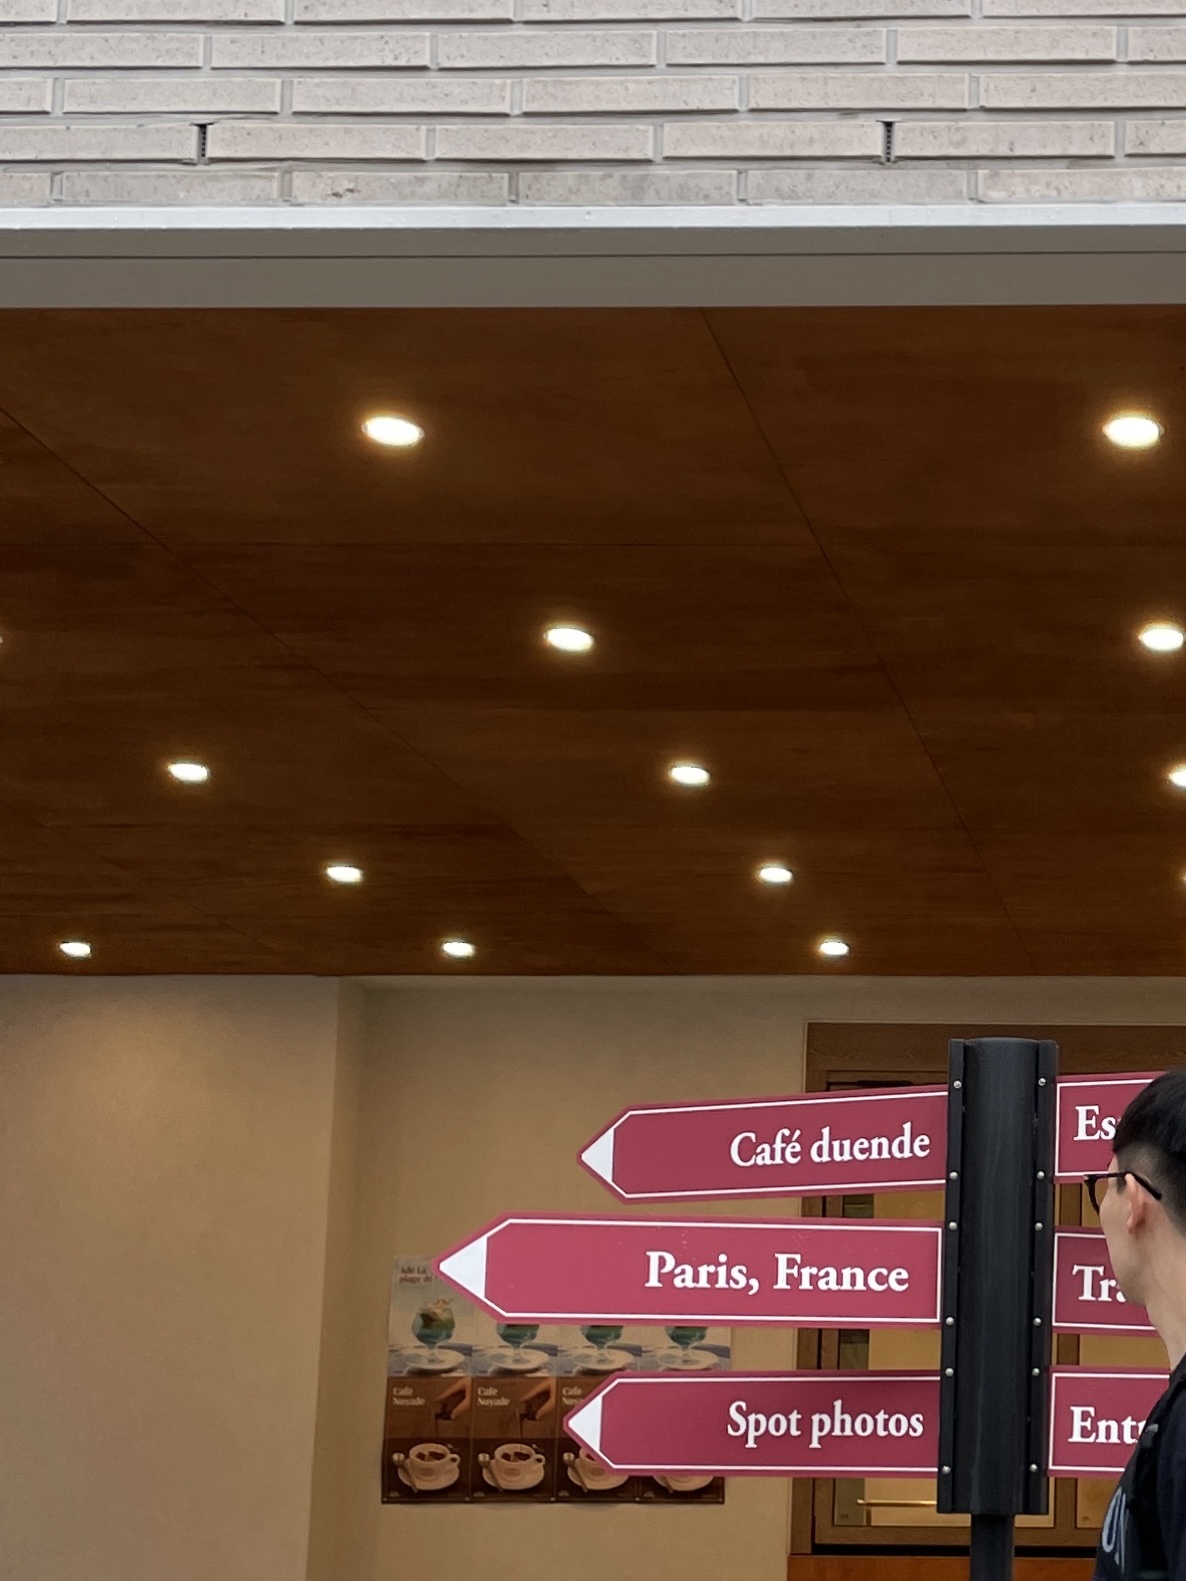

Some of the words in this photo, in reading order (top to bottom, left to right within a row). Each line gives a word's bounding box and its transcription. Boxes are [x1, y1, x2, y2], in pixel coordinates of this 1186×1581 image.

[729, 1127, 802, 1167] Café
[810, 1121, 931, 1163] duende
[644, 1250, 760, 1296] Paris,
[772, 1252, 910, 1292] France
[727, 1400, 802, 1448] Spot
[809, 1399, 925, 1449] photos
